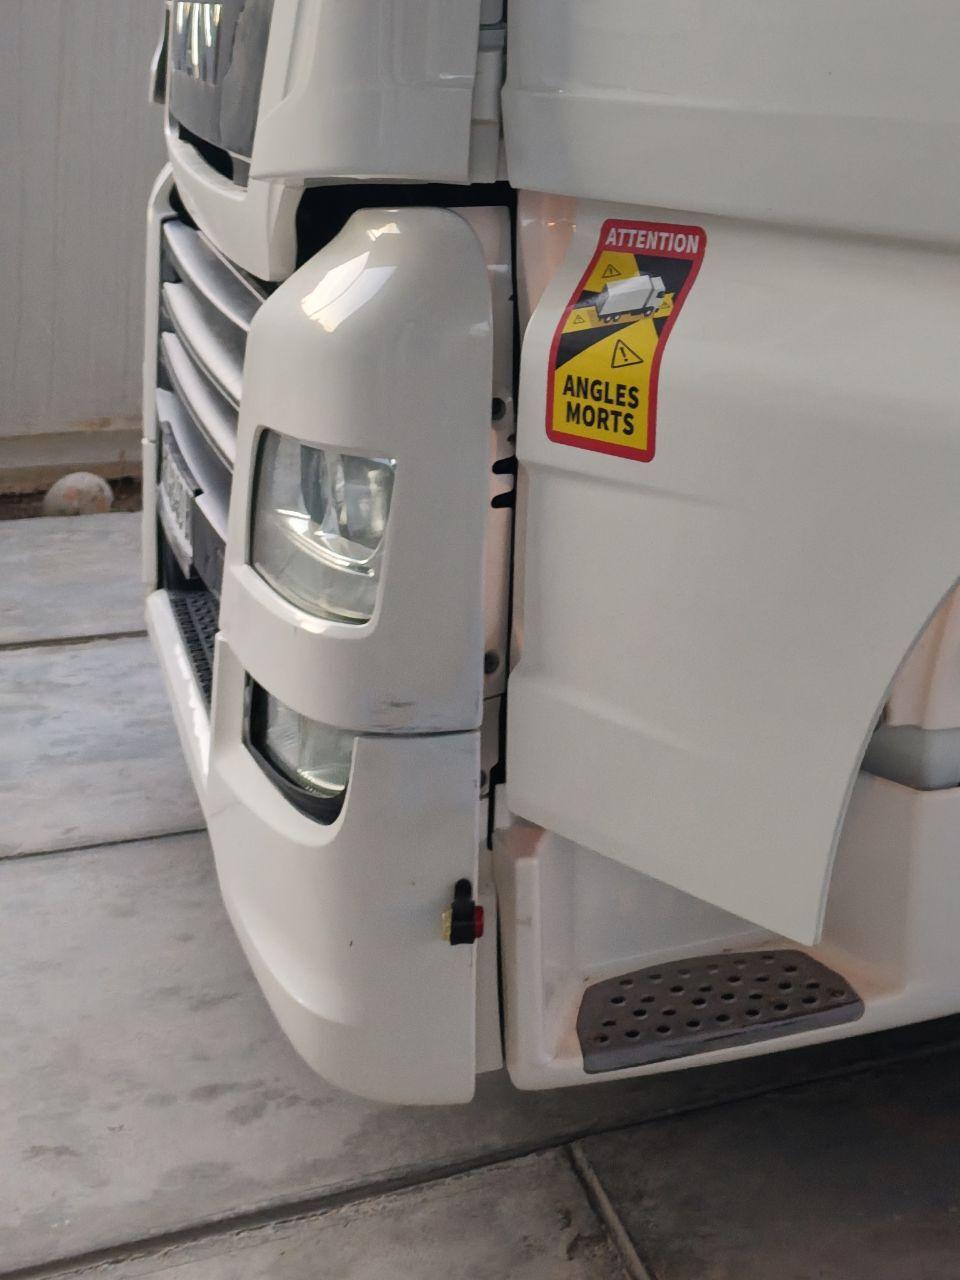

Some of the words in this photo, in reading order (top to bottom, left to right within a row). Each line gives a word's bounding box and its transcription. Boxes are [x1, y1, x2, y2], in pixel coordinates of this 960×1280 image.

[605, 227, 699, 254] ATTENTION
[562, 374, 640, 410] ANGLES
[566, 400, 635, 436] MORTS
